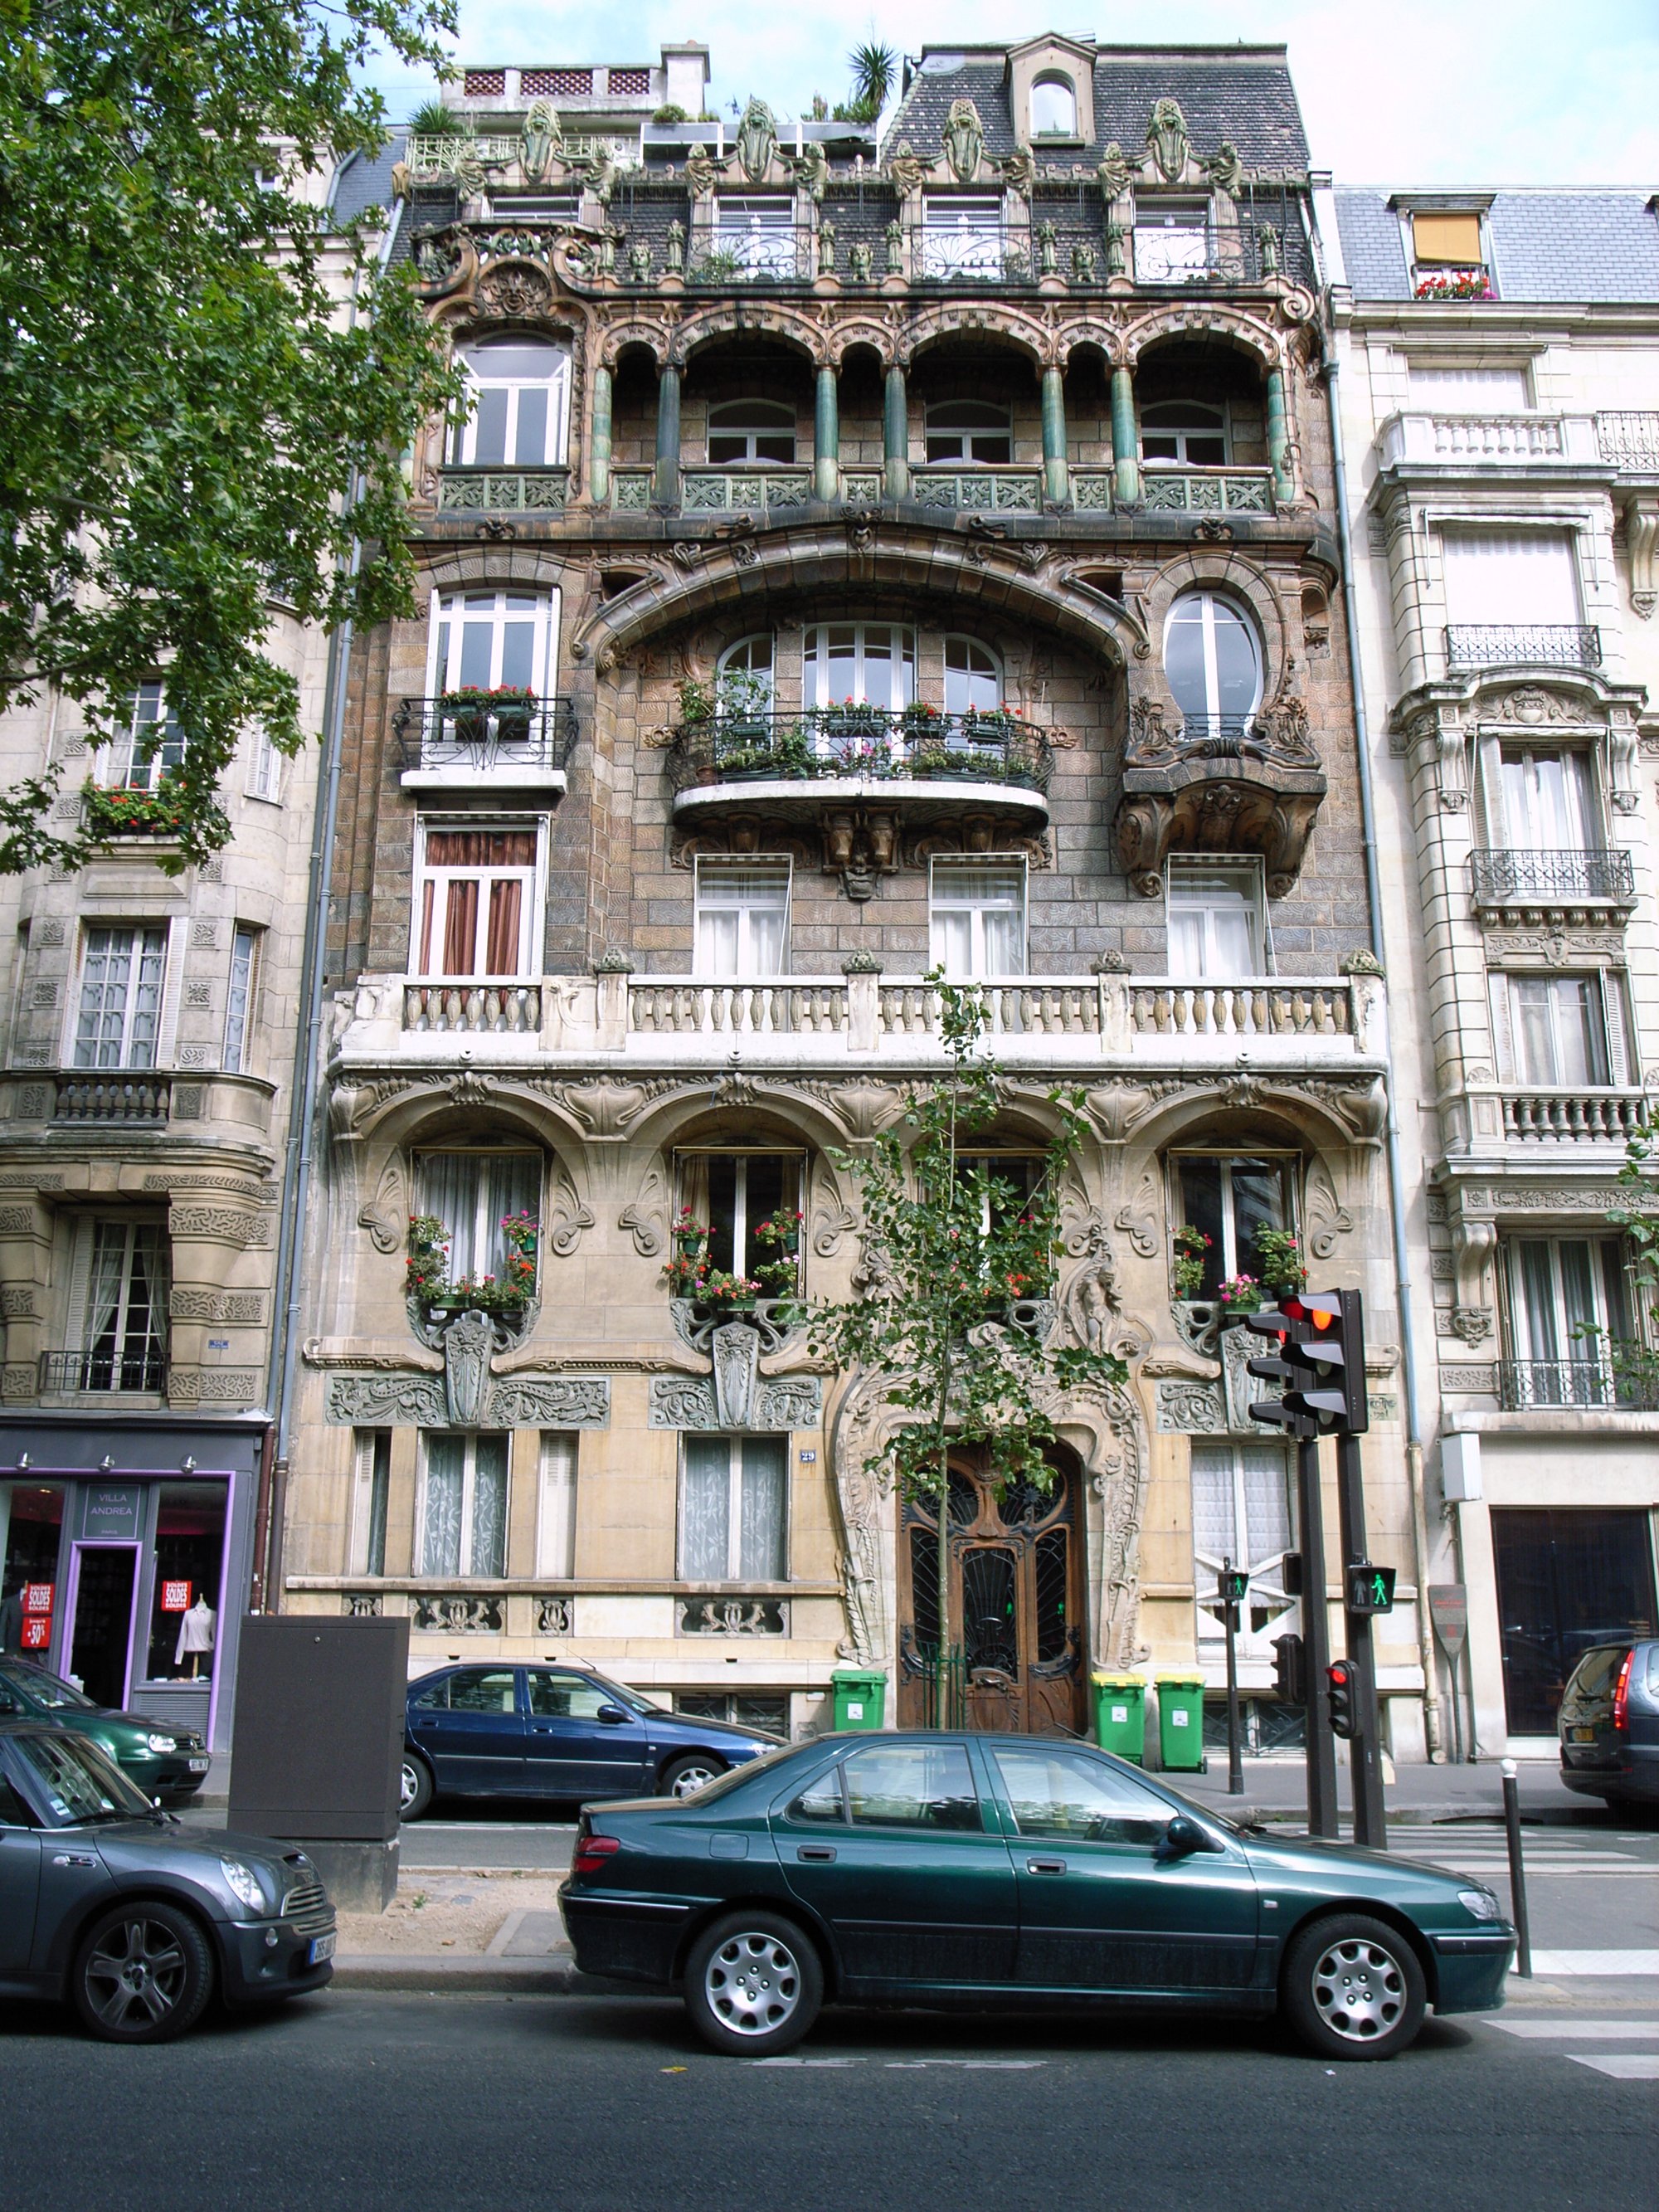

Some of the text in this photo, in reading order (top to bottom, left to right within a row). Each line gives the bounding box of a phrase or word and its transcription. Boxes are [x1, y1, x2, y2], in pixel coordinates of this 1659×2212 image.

[801, 1452, 815, 1461] 29
[100, 1493, 128, 1502] VILLA
[90, 1507, 134, 1515] ANDREA
[28, 1591, 51, 1605] SOLDES
[165, 1588, 187, 1603] SOLDES
